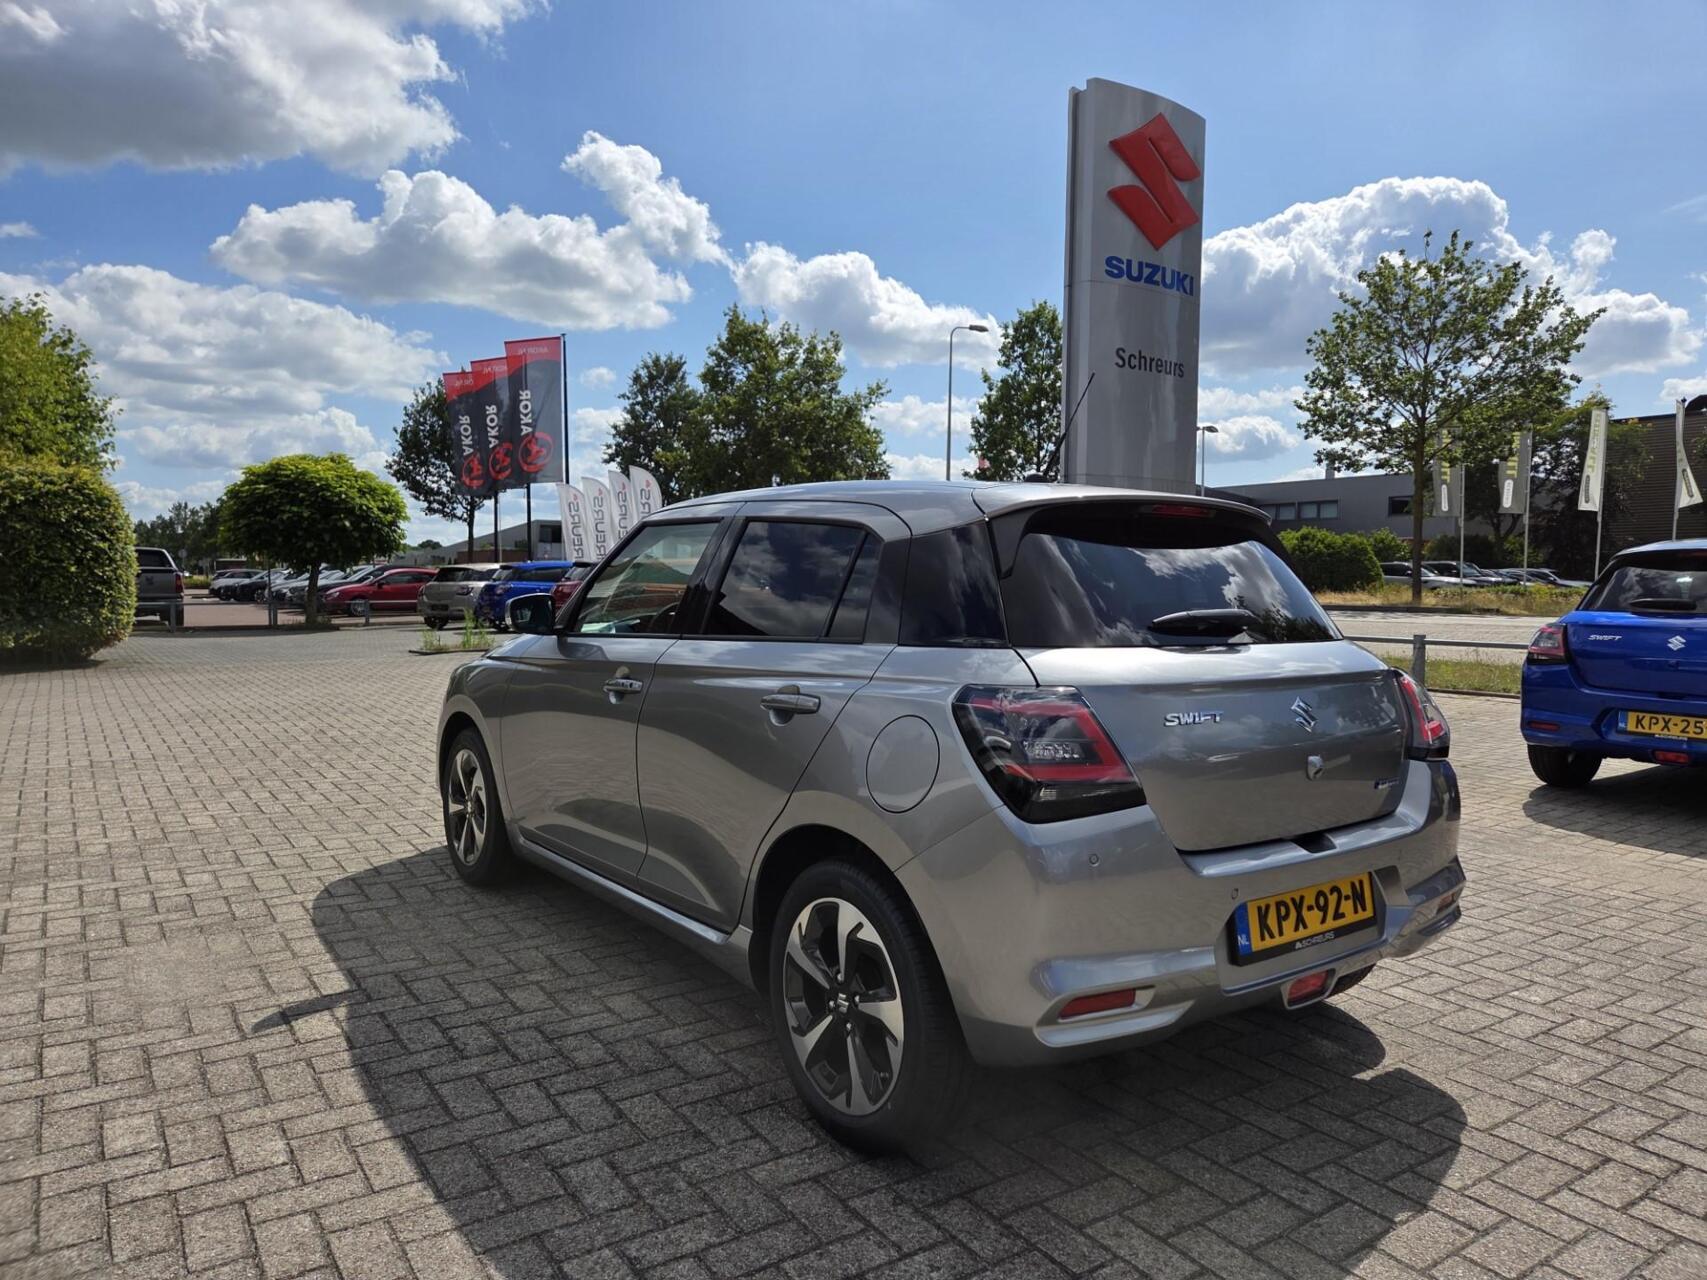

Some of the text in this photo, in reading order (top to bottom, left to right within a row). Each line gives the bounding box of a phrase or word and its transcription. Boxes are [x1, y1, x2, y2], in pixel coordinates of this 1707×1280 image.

[1105, 256, 1194, 296] SUZUKI
[1115, 347, 1184, 379] Schreurs
[1164, 711, 1223, 727] SWIFT
[1635, 715, 1707, 735] KPX-25
[1257, 879, 1367, 941] KPX-92-N
[1237, 934, 1249, 946] NL
